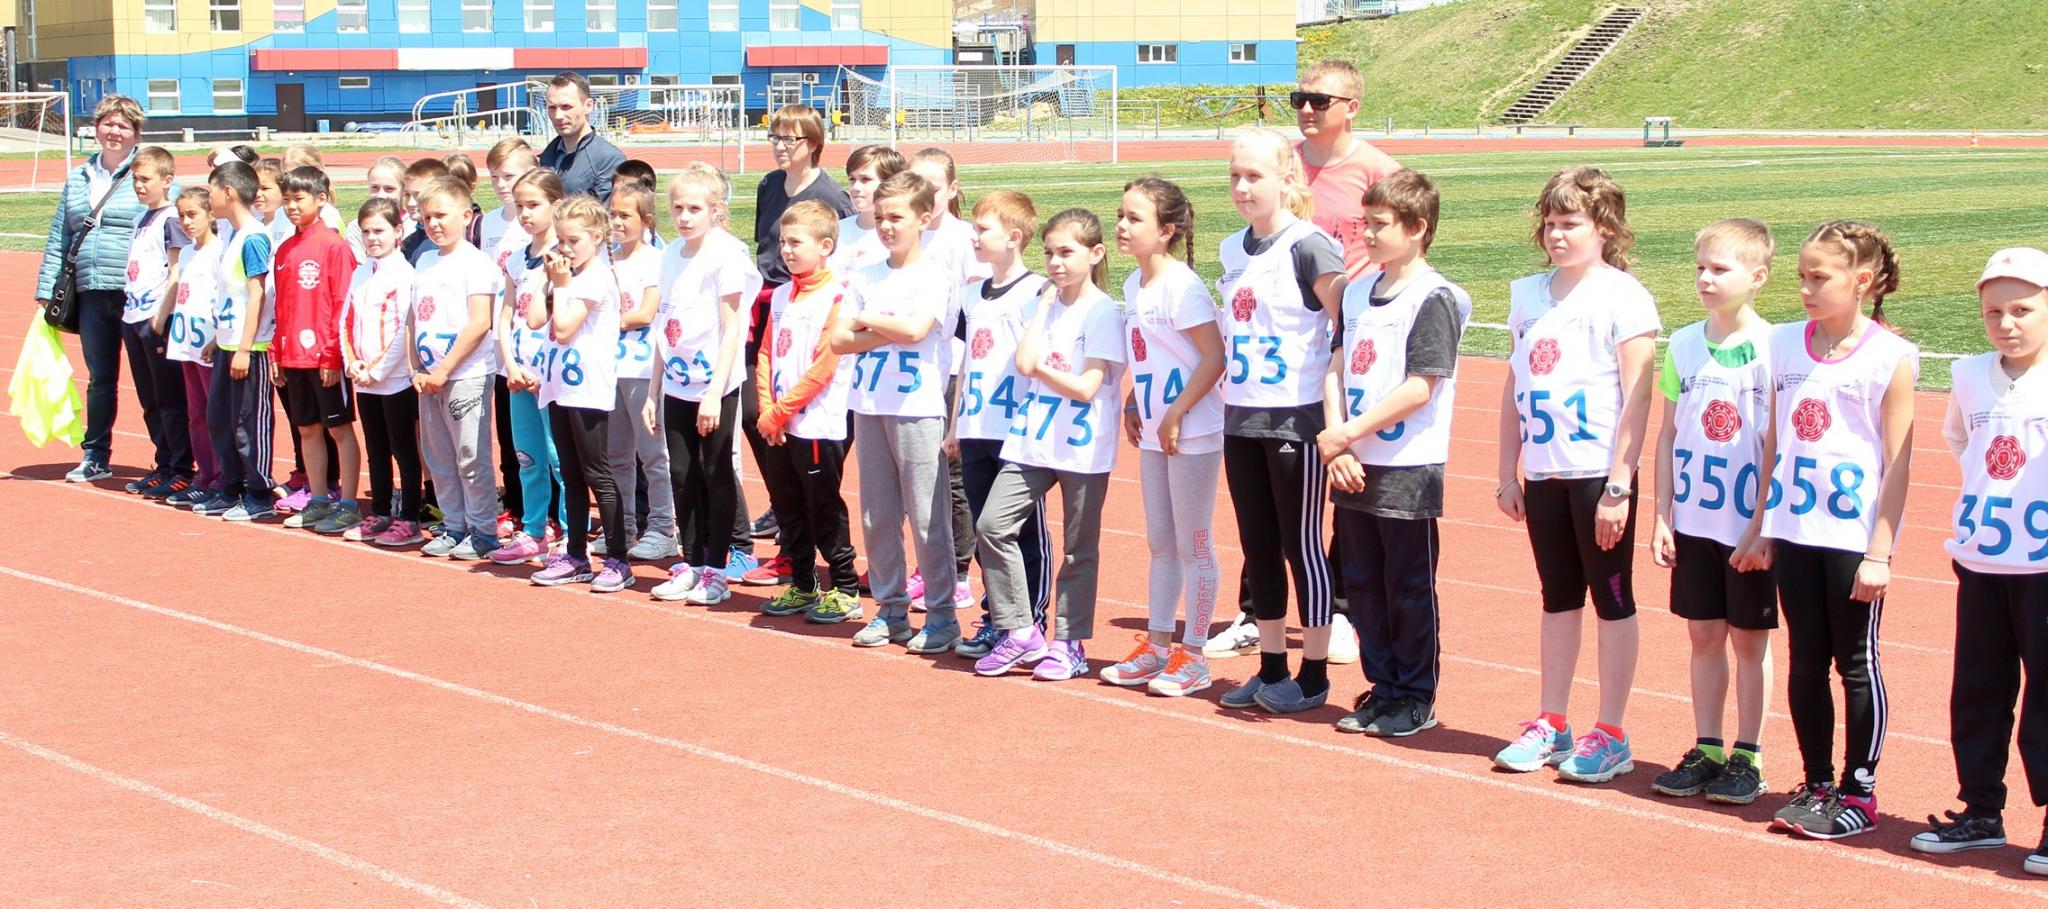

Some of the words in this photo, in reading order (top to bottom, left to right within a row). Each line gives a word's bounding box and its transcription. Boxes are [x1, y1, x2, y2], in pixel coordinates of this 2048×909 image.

[1673, 448, 1760, 519] 350
[1193, 528, 1214, 571] LIFE
[1193, 576, 1216, 638] SPORT
